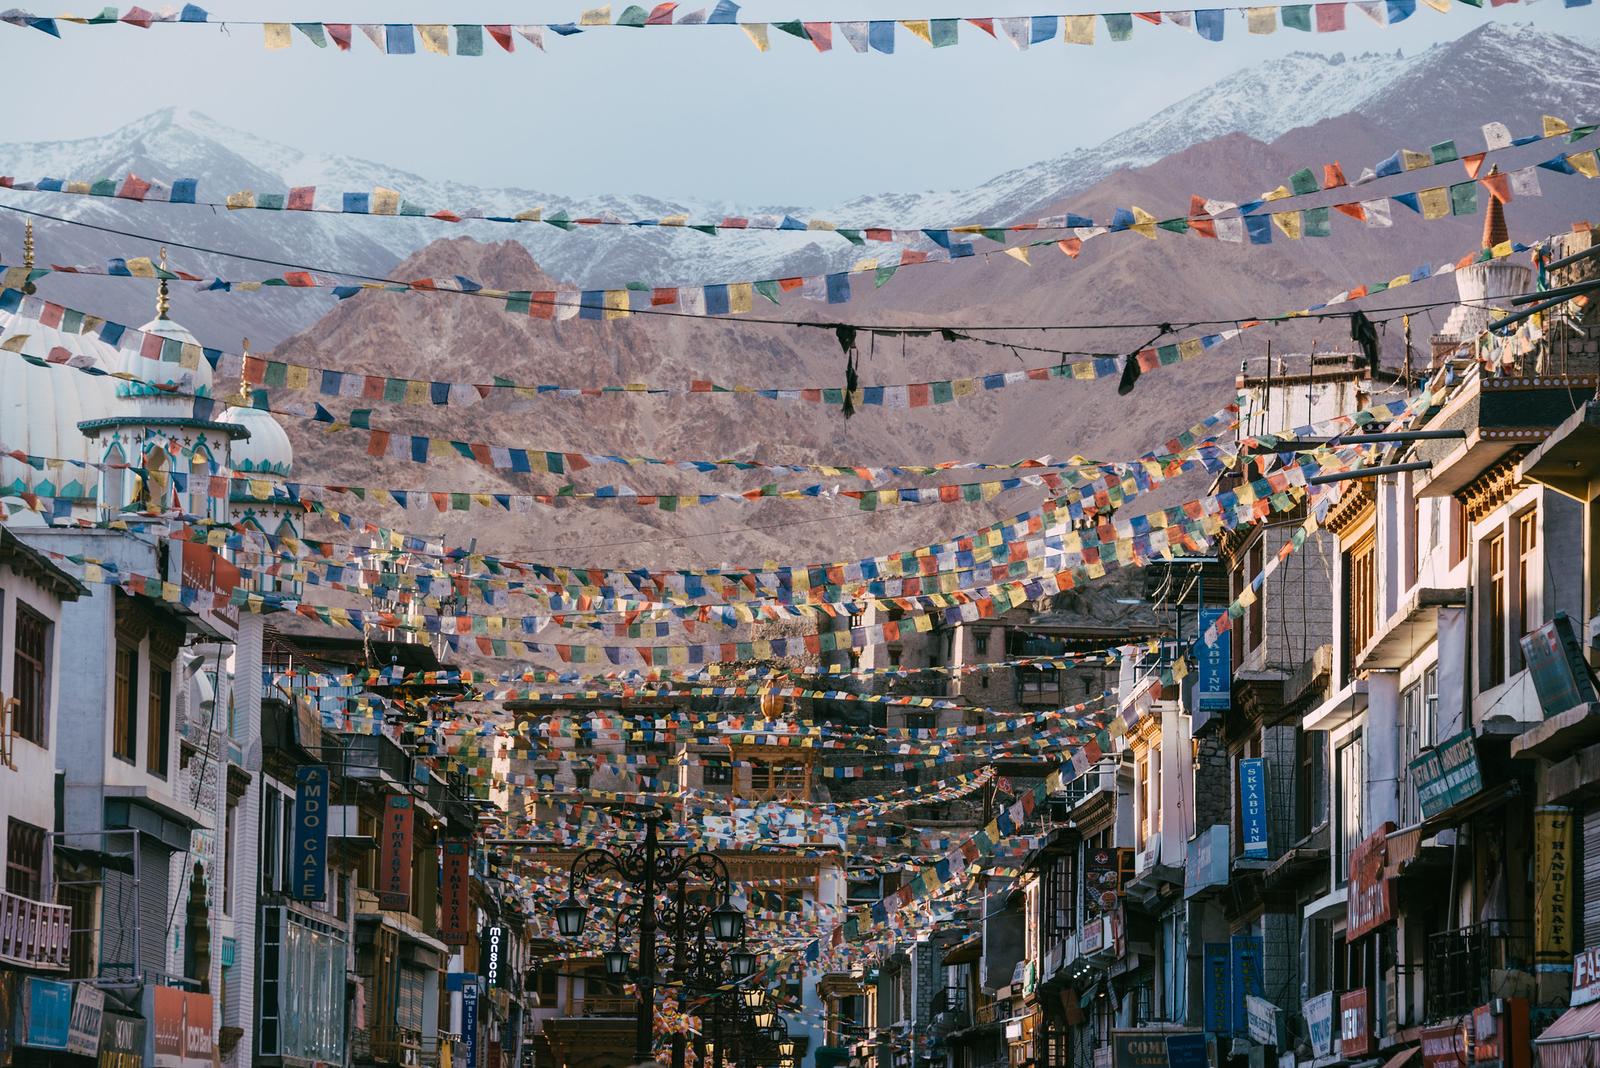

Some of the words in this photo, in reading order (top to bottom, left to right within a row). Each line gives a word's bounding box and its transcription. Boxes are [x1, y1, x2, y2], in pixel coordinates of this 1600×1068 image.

[1208, 619, 1225, 665] SABU
[1209, 670, 1225, 692] INN
[303, 769, 321, 829] AMDO
[1247, 768, 1259, 815] SKYABU
[390, 814, 404, 891] HIMALAYAN
[1250, 819, 1260, 842] INN
[303, 838, 319, 897] CAFE
[1552, 841, 1565, 945] HANDICRAFT
